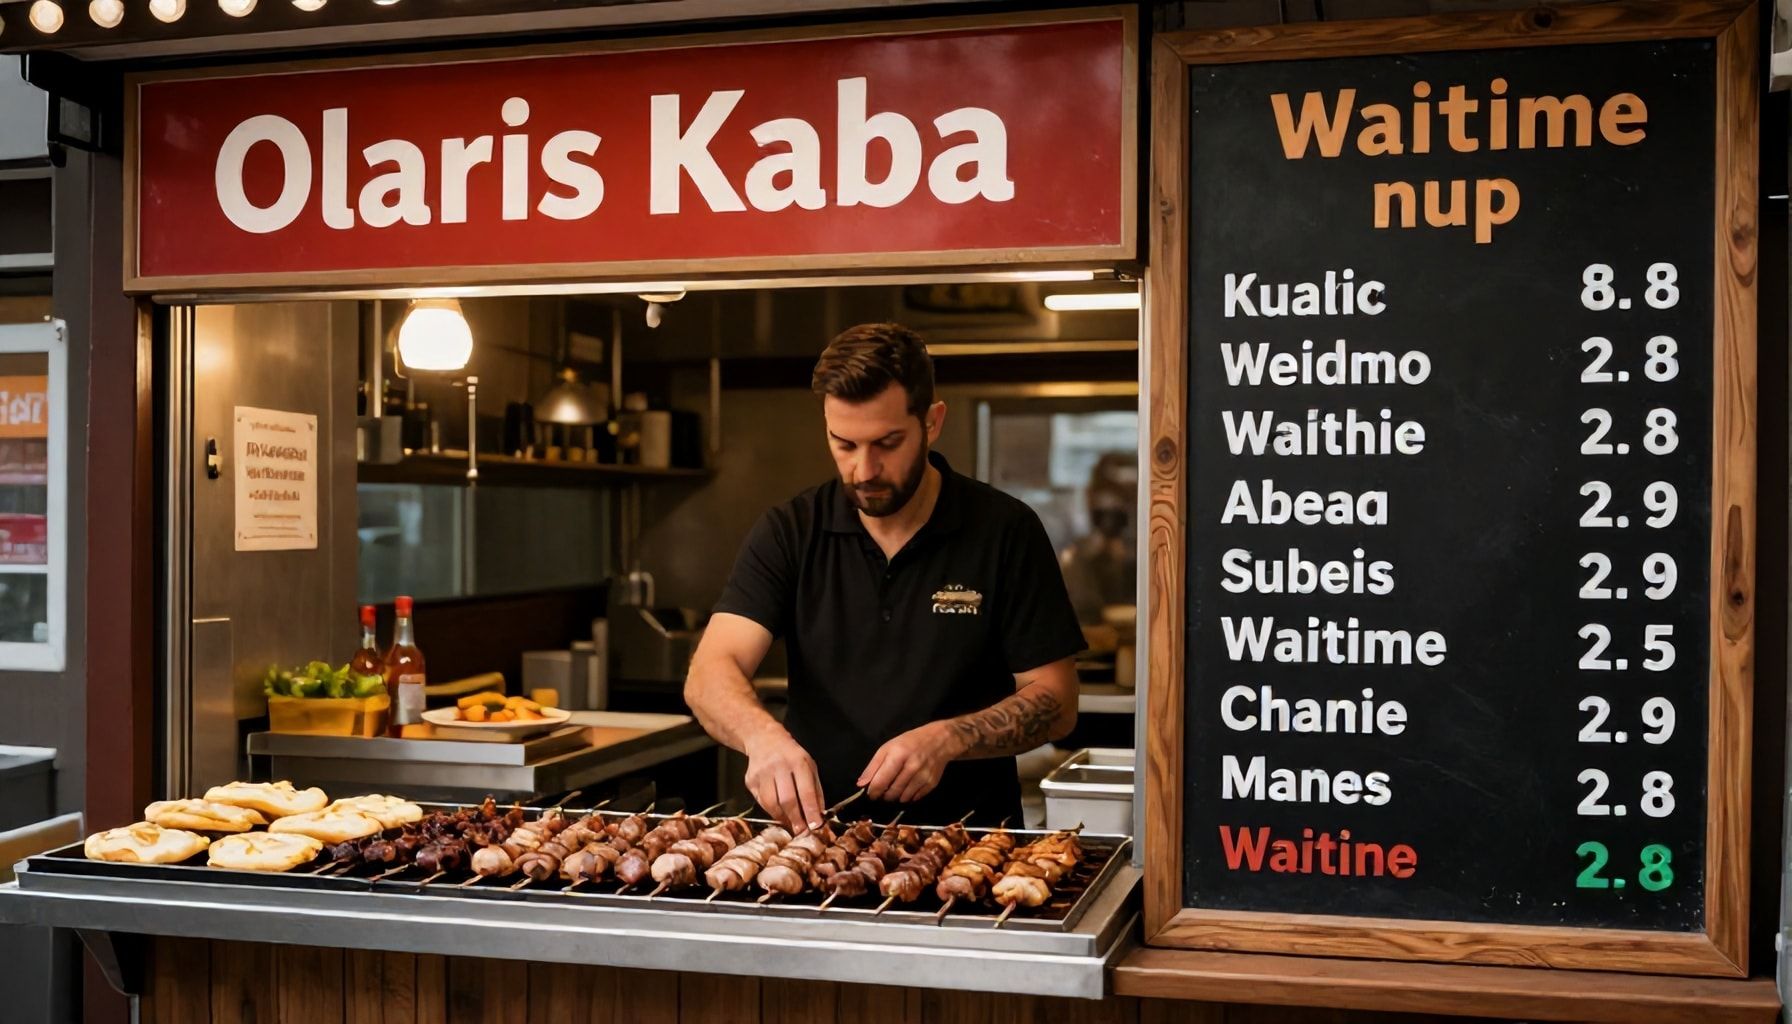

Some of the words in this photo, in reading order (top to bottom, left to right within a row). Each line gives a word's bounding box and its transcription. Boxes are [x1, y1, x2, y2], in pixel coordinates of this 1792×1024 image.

[1271, 78, 1647, 159] Waitime
[216, 97, 604, 233] Olaris
[650, 77, 1014, 214] Kaba
[1374, 179, 1520, 243] nup
[1225, 269, 1386, 317] Kualic
[1221, 339, 1431, 386] Weidmo
[1222, 409, 1425, 455] Waithie
[1221, 548, 1394, 595] Subeis
[1221, 617, 1446, 666] Waitime
[1221, 685, 1407, 735] Chanie
[1222, 755, 1391, 805] Manes
[1220, 826, 1417, 877] Waitine
